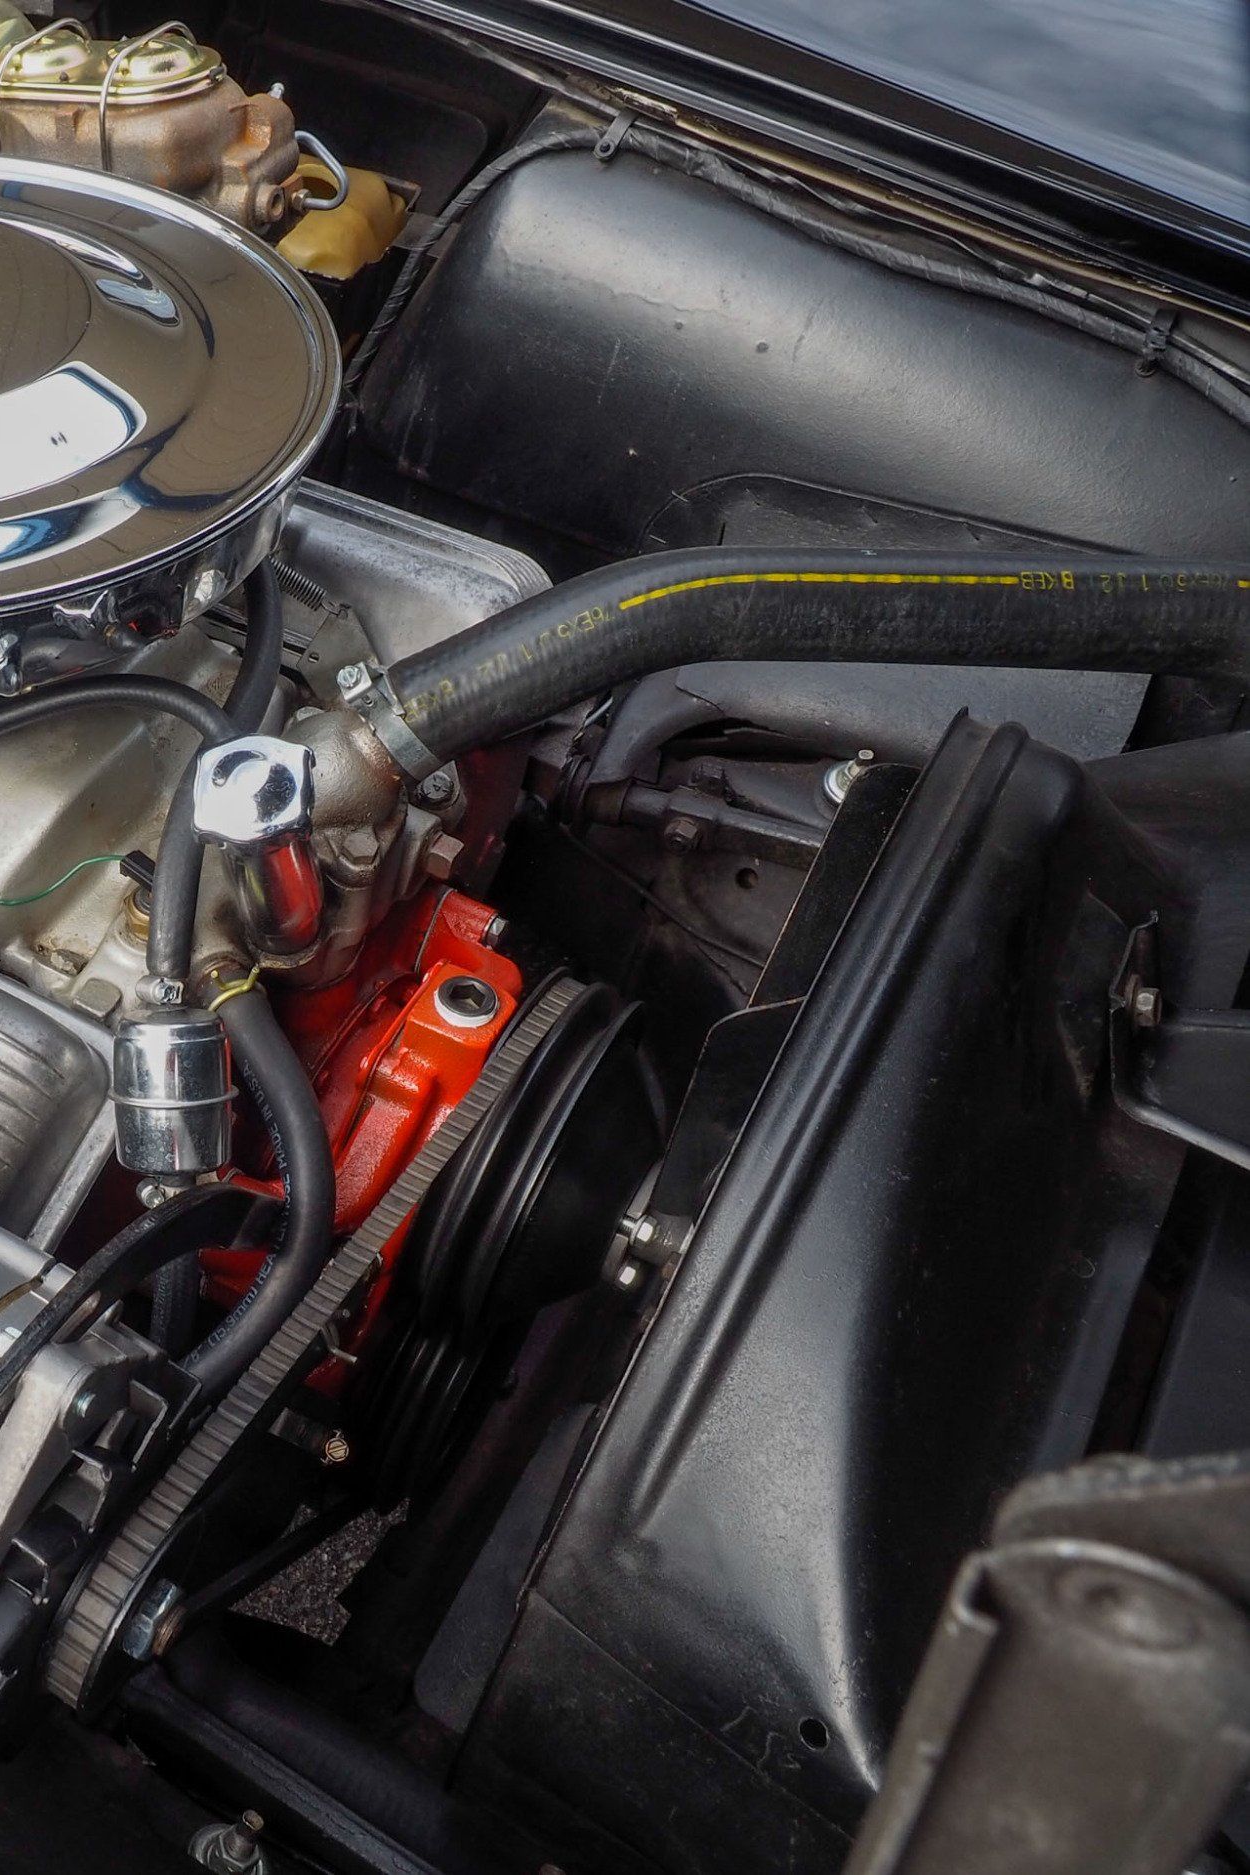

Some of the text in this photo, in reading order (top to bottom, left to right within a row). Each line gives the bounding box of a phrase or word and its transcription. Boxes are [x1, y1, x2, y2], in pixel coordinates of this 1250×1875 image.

[241, 1059, 267, 1105] U.S.A.
[259, 1103, 275, 1122] IN
[266, 1122, 288, 1170] MADE
